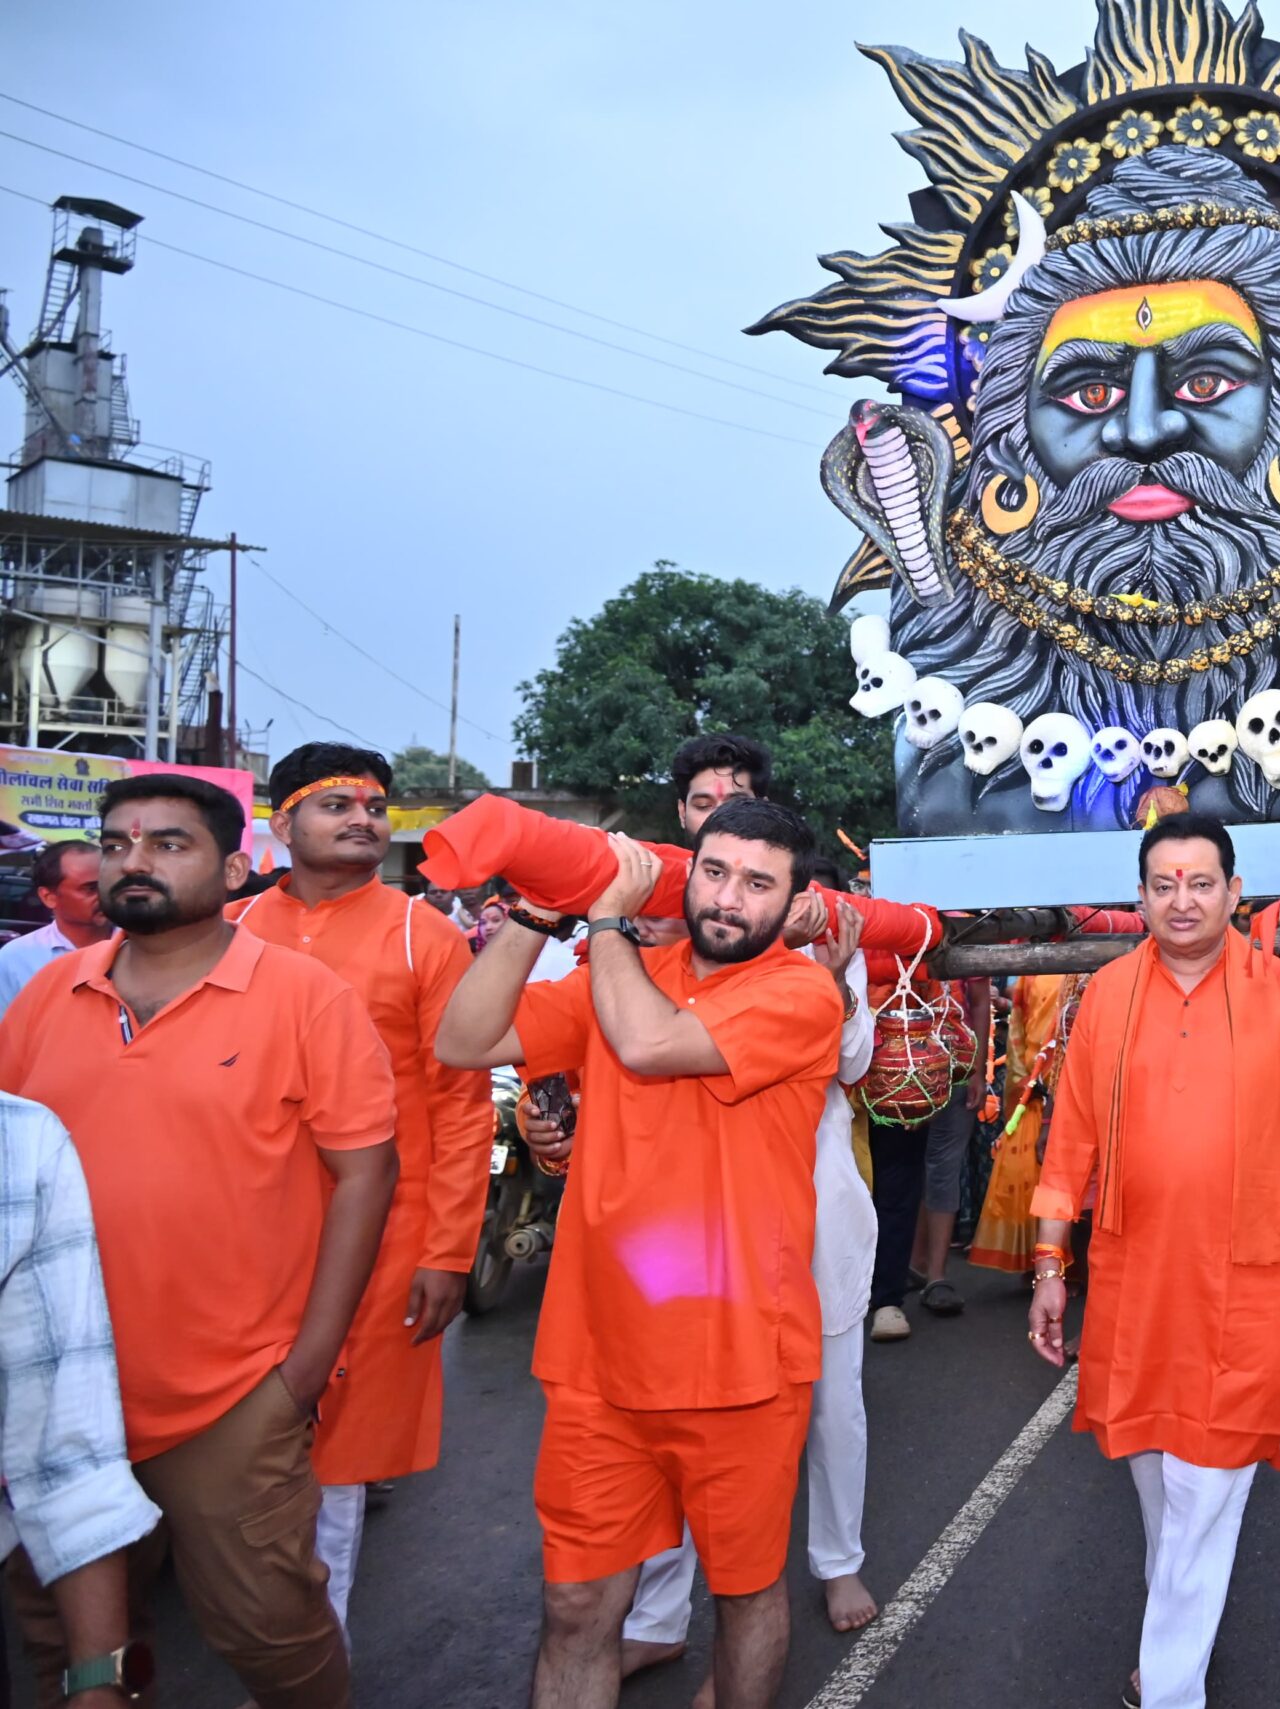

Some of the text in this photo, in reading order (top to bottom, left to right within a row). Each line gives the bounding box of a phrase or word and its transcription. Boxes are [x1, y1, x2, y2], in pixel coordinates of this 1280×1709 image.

[57, 773, 83, 792] सेवा
[21, 794, 42, 807] सभी
[45, 794, 64, 809] शिव
